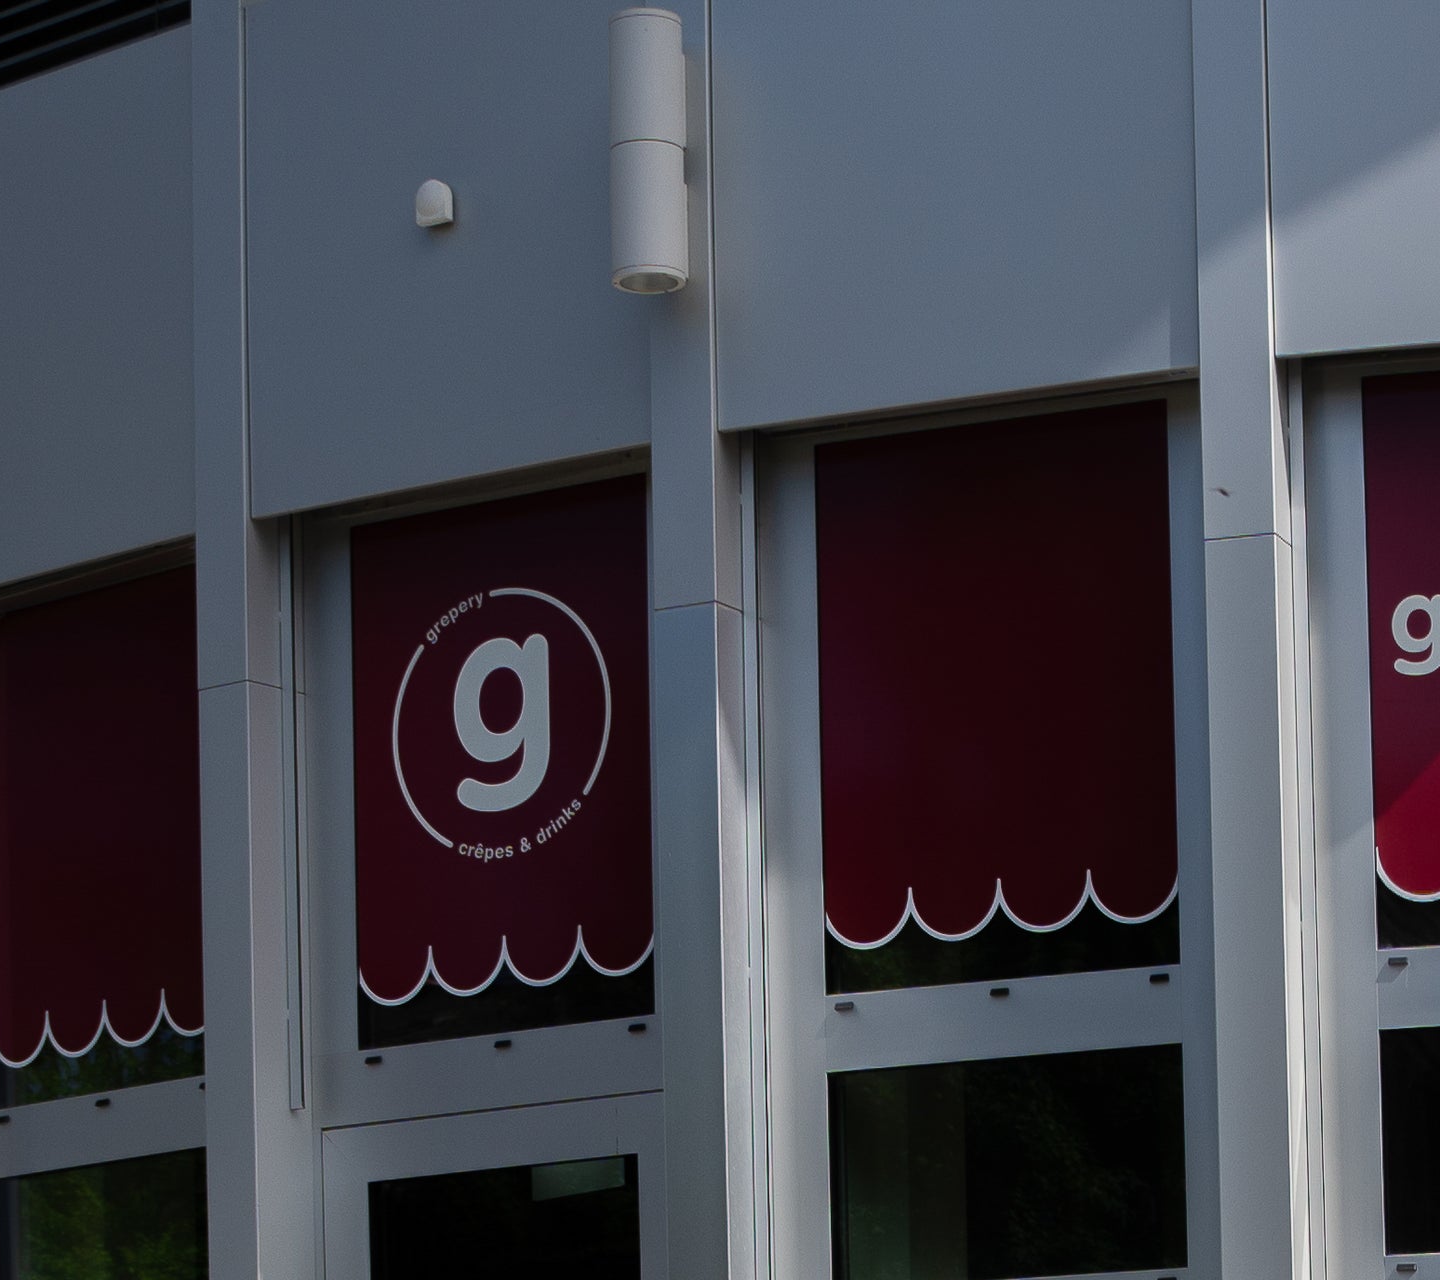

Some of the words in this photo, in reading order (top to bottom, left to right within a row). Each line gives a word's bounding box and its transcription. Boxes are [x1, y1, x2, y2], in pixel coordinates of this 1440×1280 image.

[425, 591, 484, 645] grepery
[453, 633, 551, 812] g
[458, 842, 514, 863] crêpes
[520, 837, 532, 854] &
[536, 798, 582, 844] drinks
